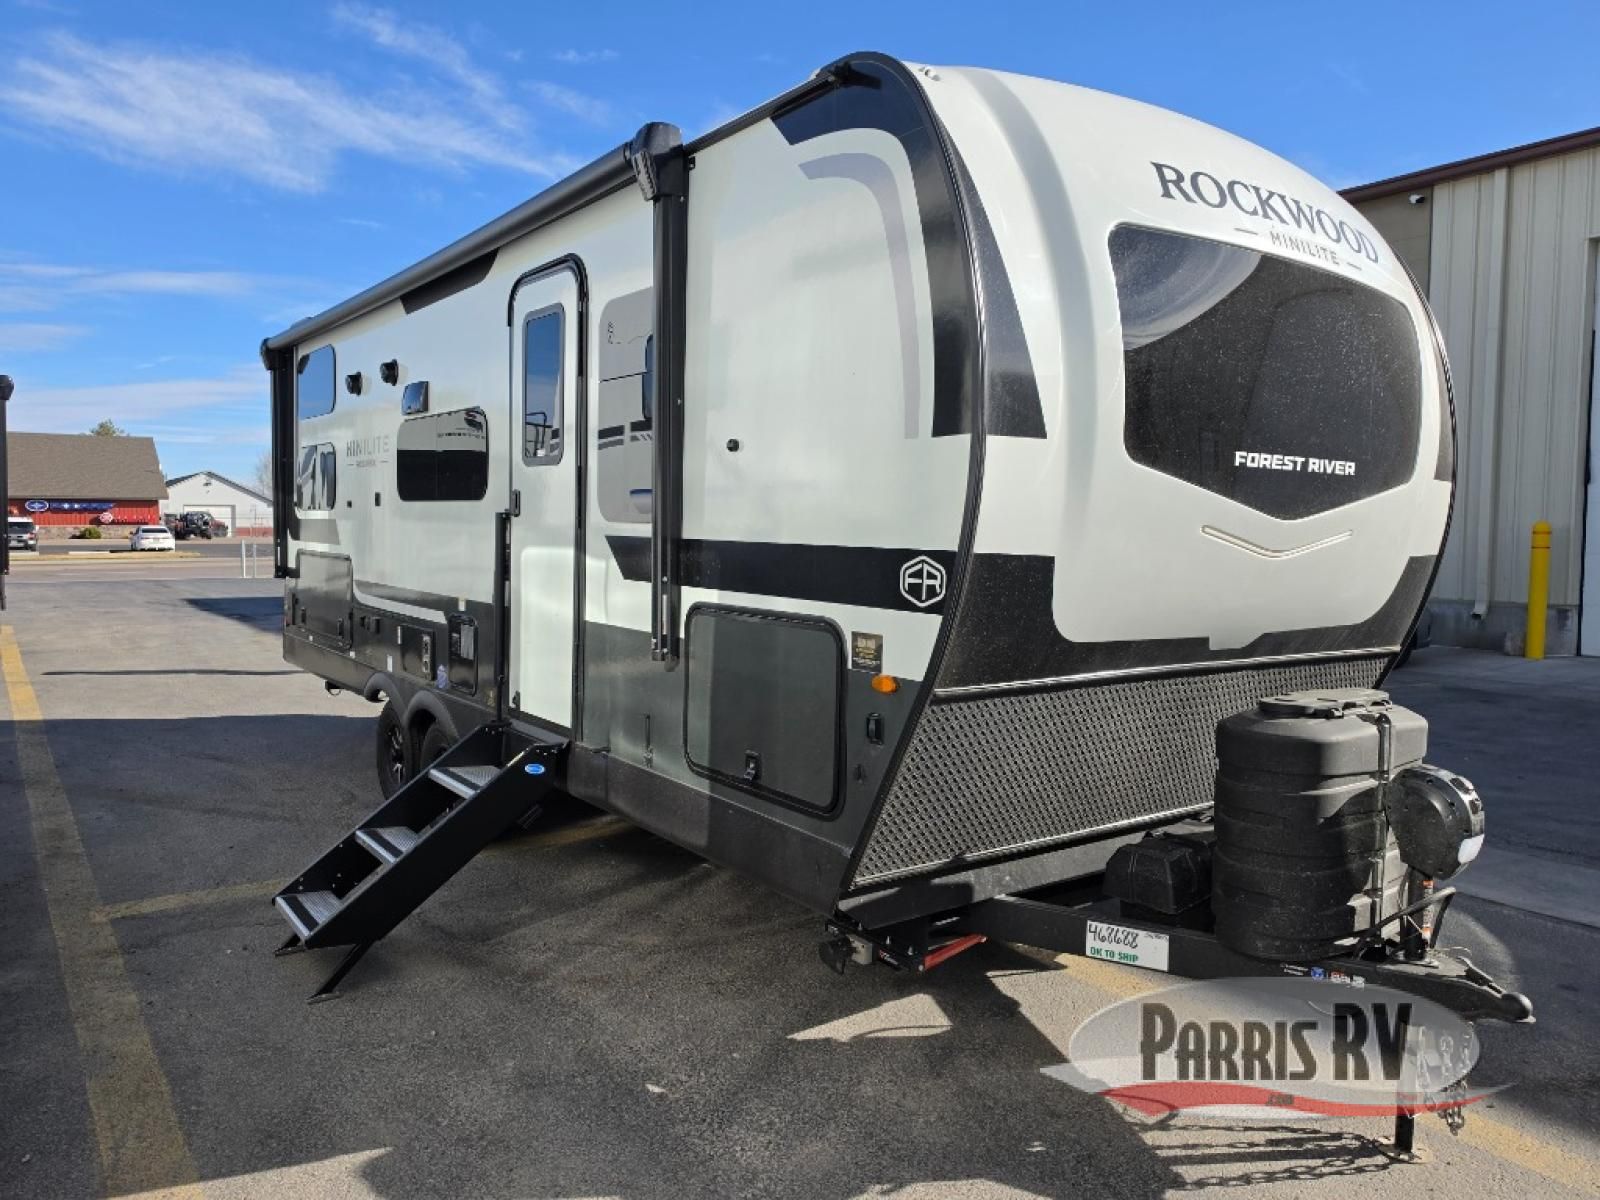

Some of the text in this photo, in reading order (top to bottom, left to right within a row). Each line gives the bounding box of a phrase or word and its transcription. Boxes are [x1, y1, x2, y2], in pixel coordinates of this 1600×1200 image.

[1151, 161, 1379, 263] ROCKWOOD
[1270, 231, 1340, 265] MINILITE
[1234, 451, 1355, 476] FOREST RIVER
[1090, 946, 1139, 962] OK TO SHIP
